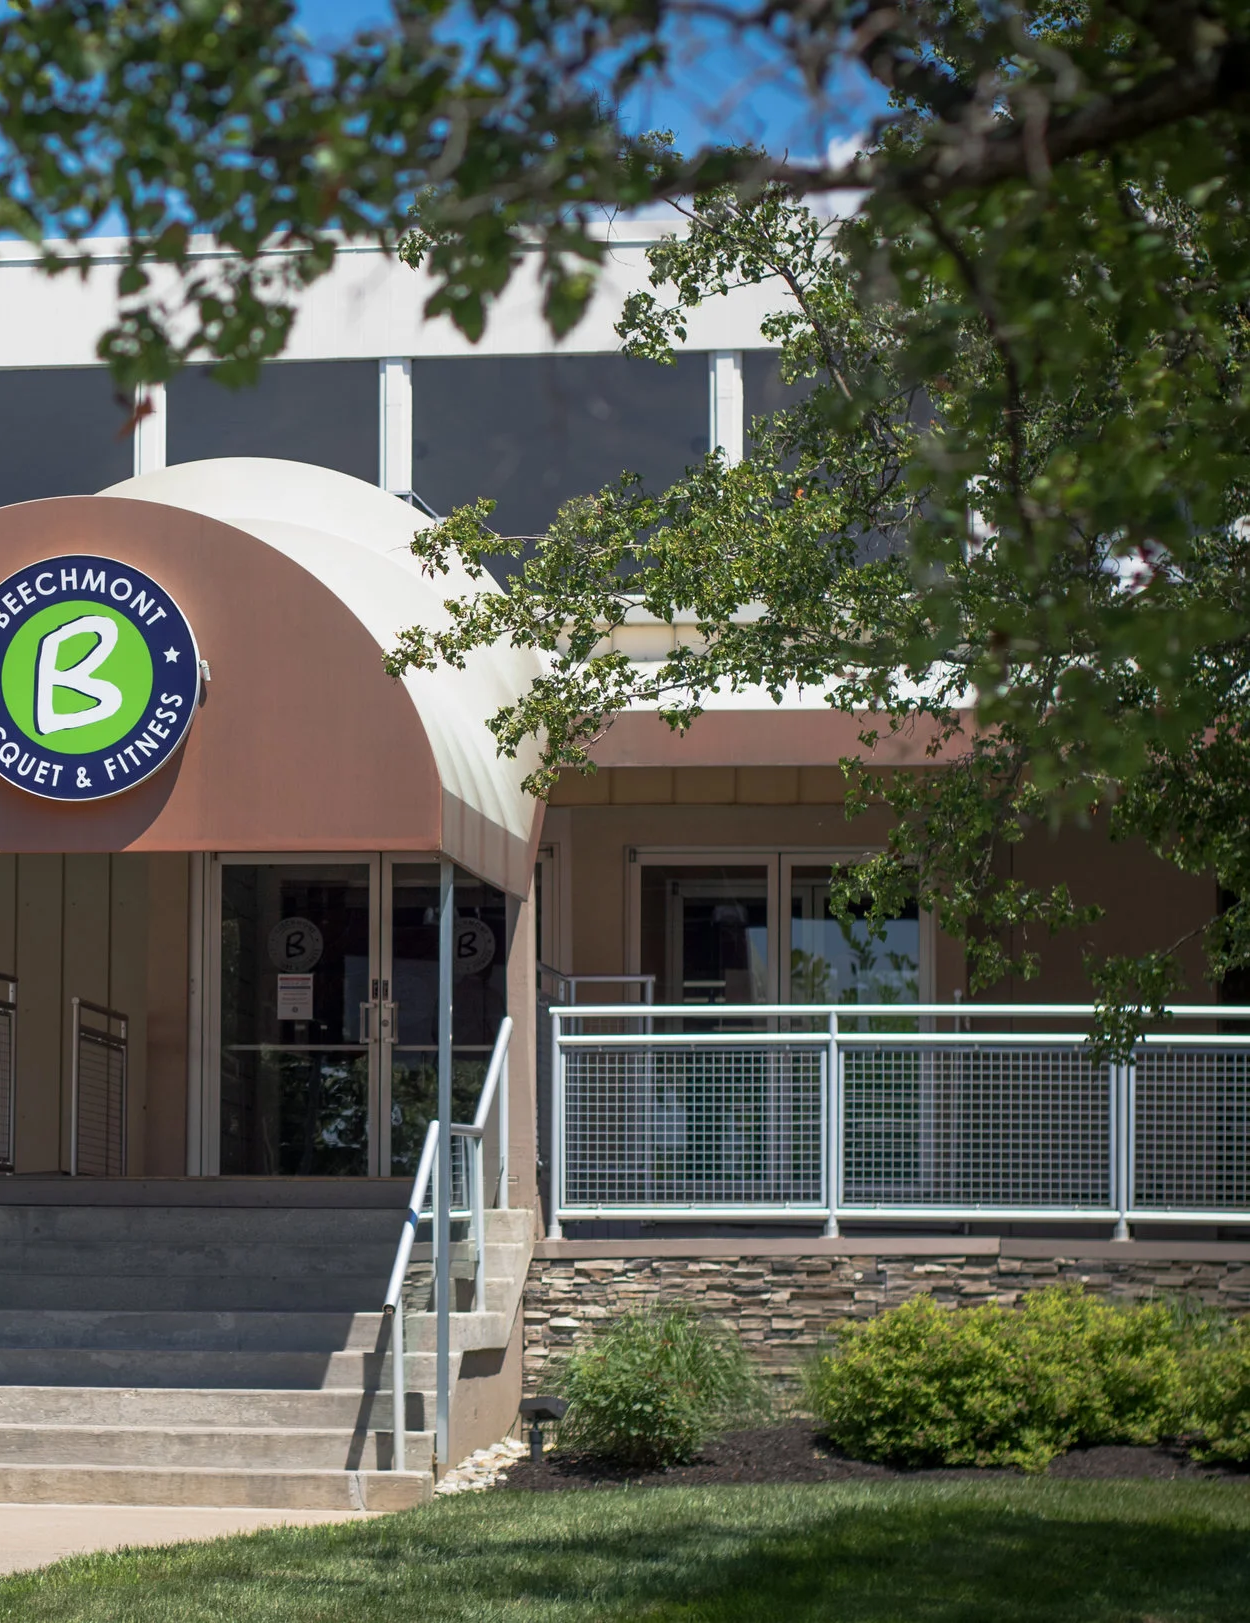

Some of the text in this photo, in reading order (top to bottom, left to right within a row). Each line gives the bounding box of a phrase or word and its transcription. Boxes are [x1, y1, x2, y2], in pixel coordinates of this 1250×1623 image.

[33, 615, 123, 735] B
[76, 767, 92, 788] &
[103, 692, 183, 781] FITNESS
[286, 931, 306, 958] B
[457, 932, 477, 958] B
